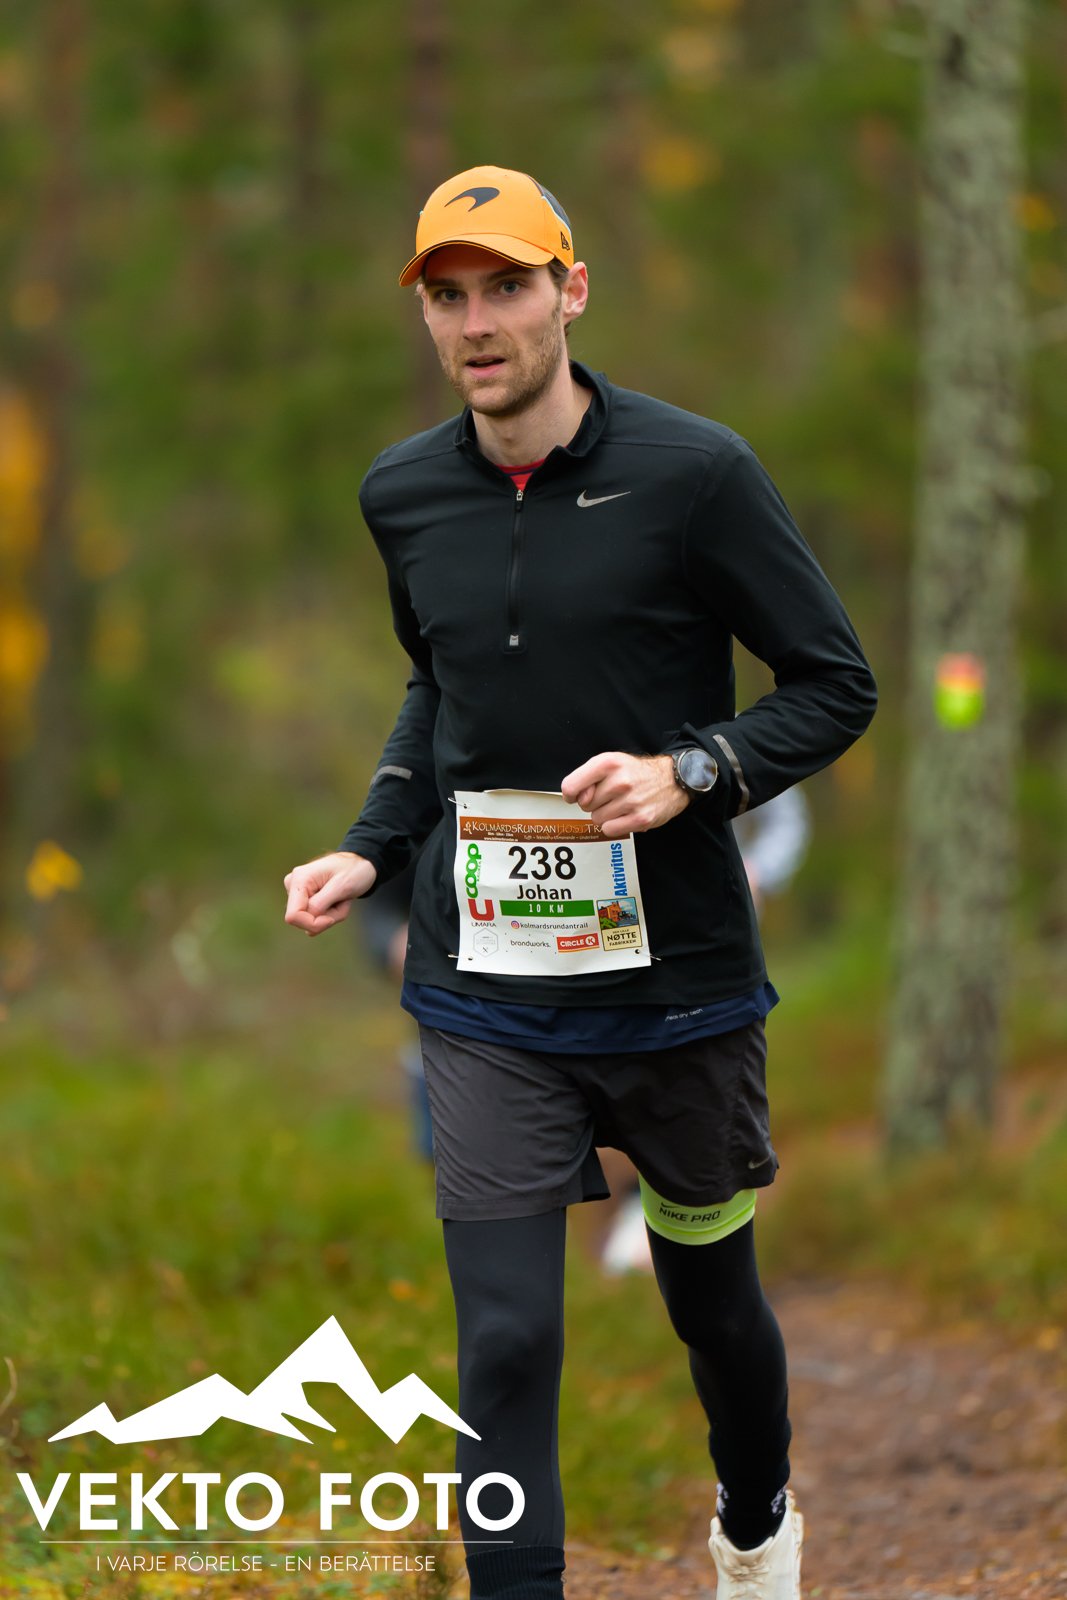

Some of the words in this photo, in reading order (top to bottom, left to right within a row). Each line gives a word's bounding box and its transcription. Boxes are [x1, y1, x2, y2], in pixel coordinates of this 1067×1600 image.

[464, 843, 482, 898] coop
[508, 846, 576, 880] 238
[611, 842, 628, 896] Aktivitus
[517, 884, 572, 900] Johan
[529, 904, 541, 913] 10
[550, 904, 564, 913] KM
[560, 938, 584, 948] CIRCLE
[606, 932, 637, 942] NØTTE
[659, 1208, 688, 1222] NIKE
[690, 1210, 721, 1223] PRO
